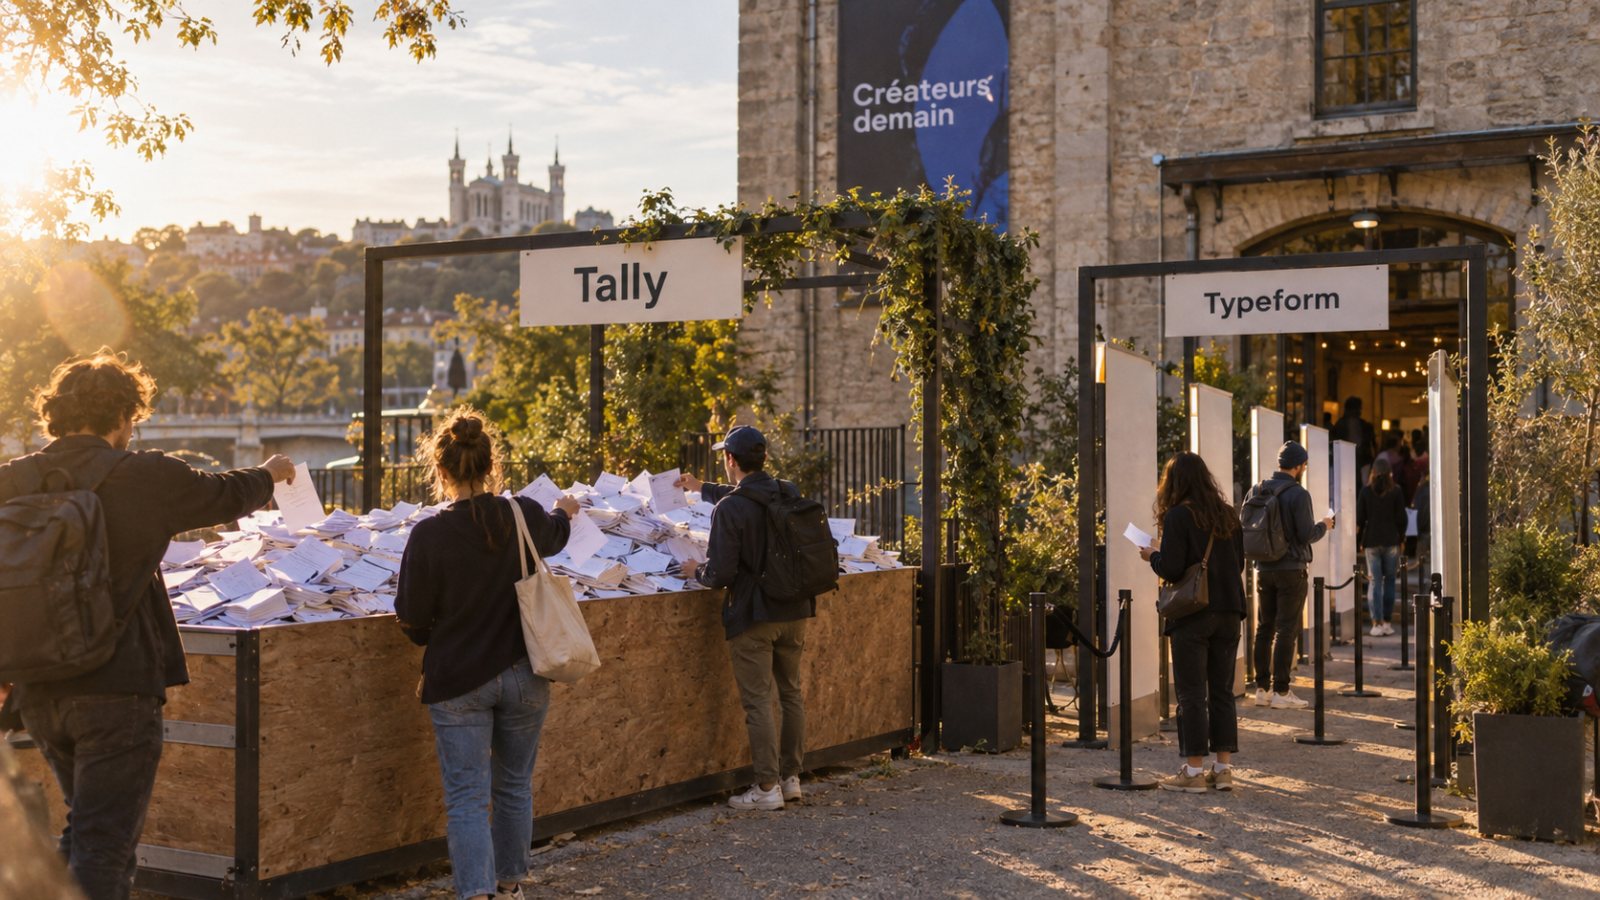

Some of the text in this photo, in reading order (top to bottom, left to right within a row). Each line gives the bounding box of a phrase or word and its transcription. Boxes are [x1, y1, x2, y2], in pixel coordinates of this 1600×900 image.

[853, 78, 990, 107] Créateurs
[853, 103, 954, 133] demain
[573, 262, 668, 309] Tally
[1203, 289, 1340, 319] Typeform
